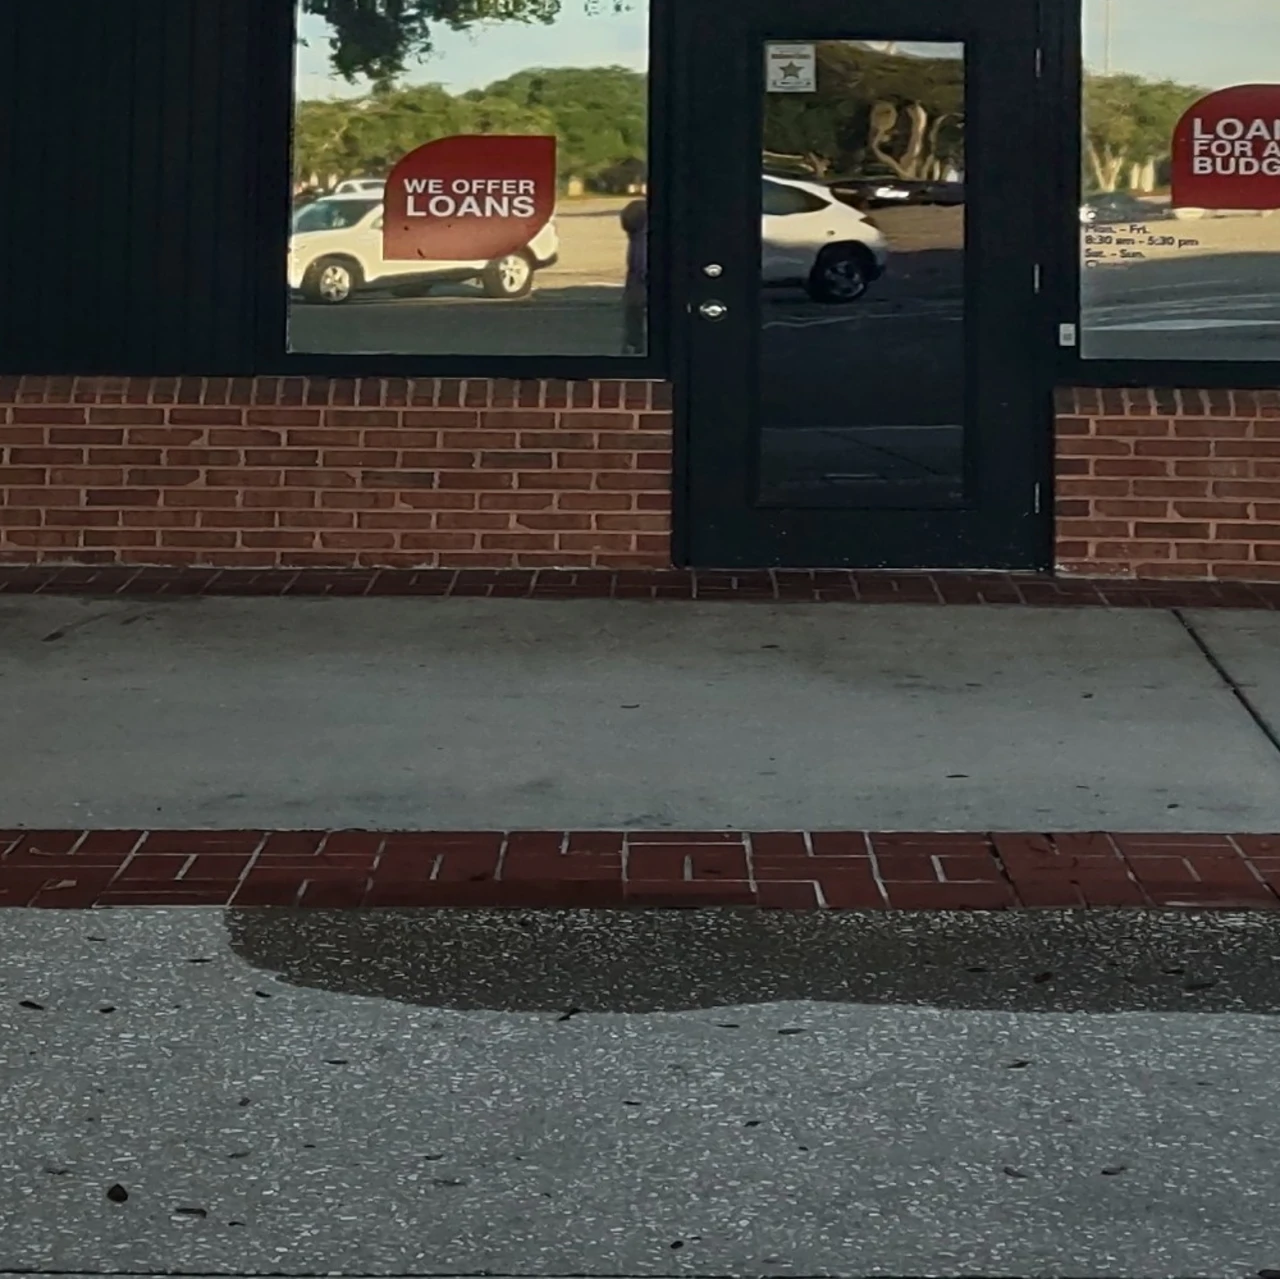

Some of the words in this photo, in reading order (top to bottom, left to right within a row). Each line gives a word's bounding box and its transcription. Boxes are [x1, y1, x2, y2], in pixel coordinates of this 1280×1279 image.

[1192, 139, 1254, 157] FOR
[404, 178, 444, 194] WE
[451, 179, 536, 195] OFFER
[405, 195, 535, 218] LOANS
[1085, 235, 1113, 245] 8:30
[1147, 236, 1175, 246] 5:30
[1178, 239, 1199, 248] pm
